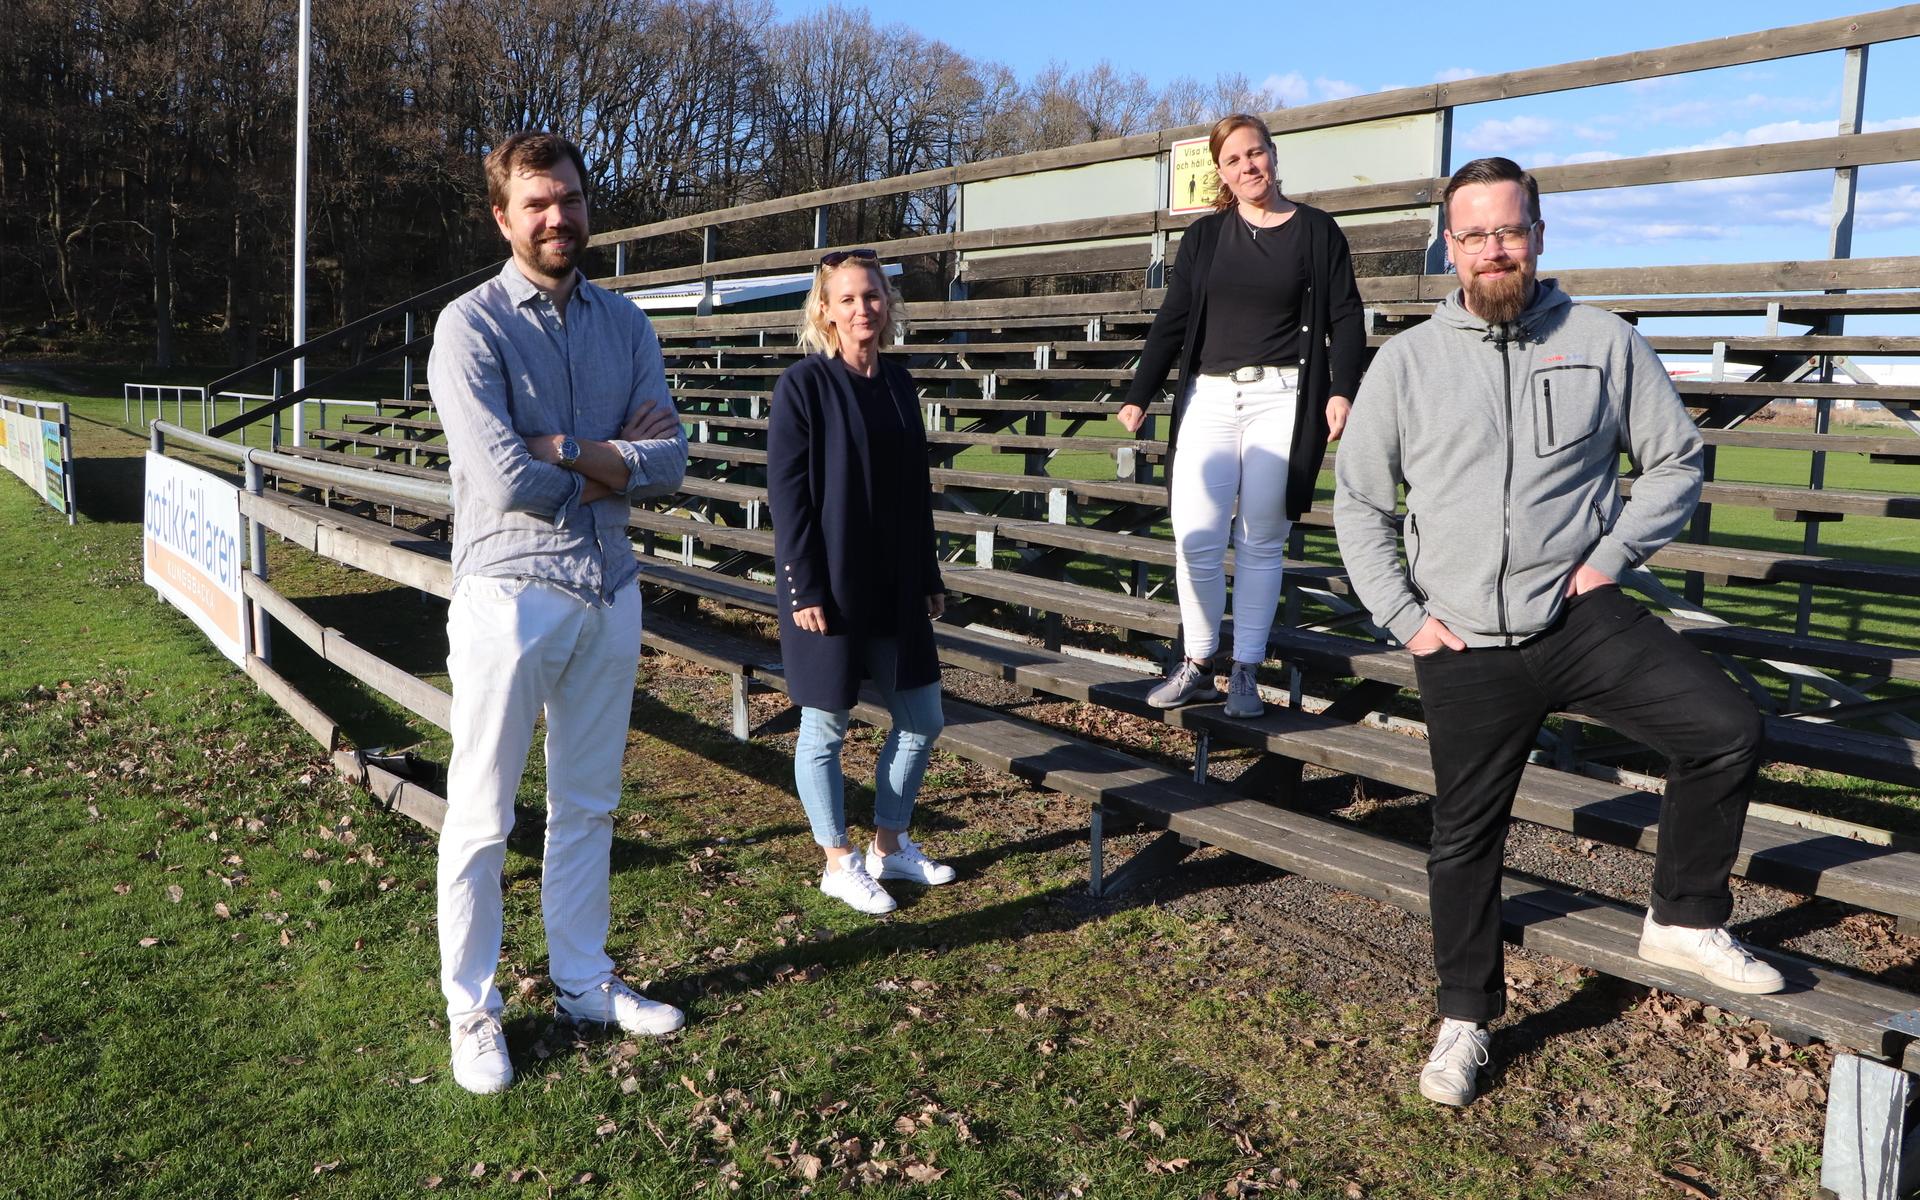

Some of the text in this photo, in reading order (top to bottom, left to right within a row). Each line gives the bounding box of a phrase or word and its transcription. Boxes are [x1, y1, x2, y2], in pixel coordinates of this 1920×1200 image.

[1184, 148, 1200, 156] Visa
[1176, 161, 1189, 170] och
[146, 476, 237, 593] optikkällaren
